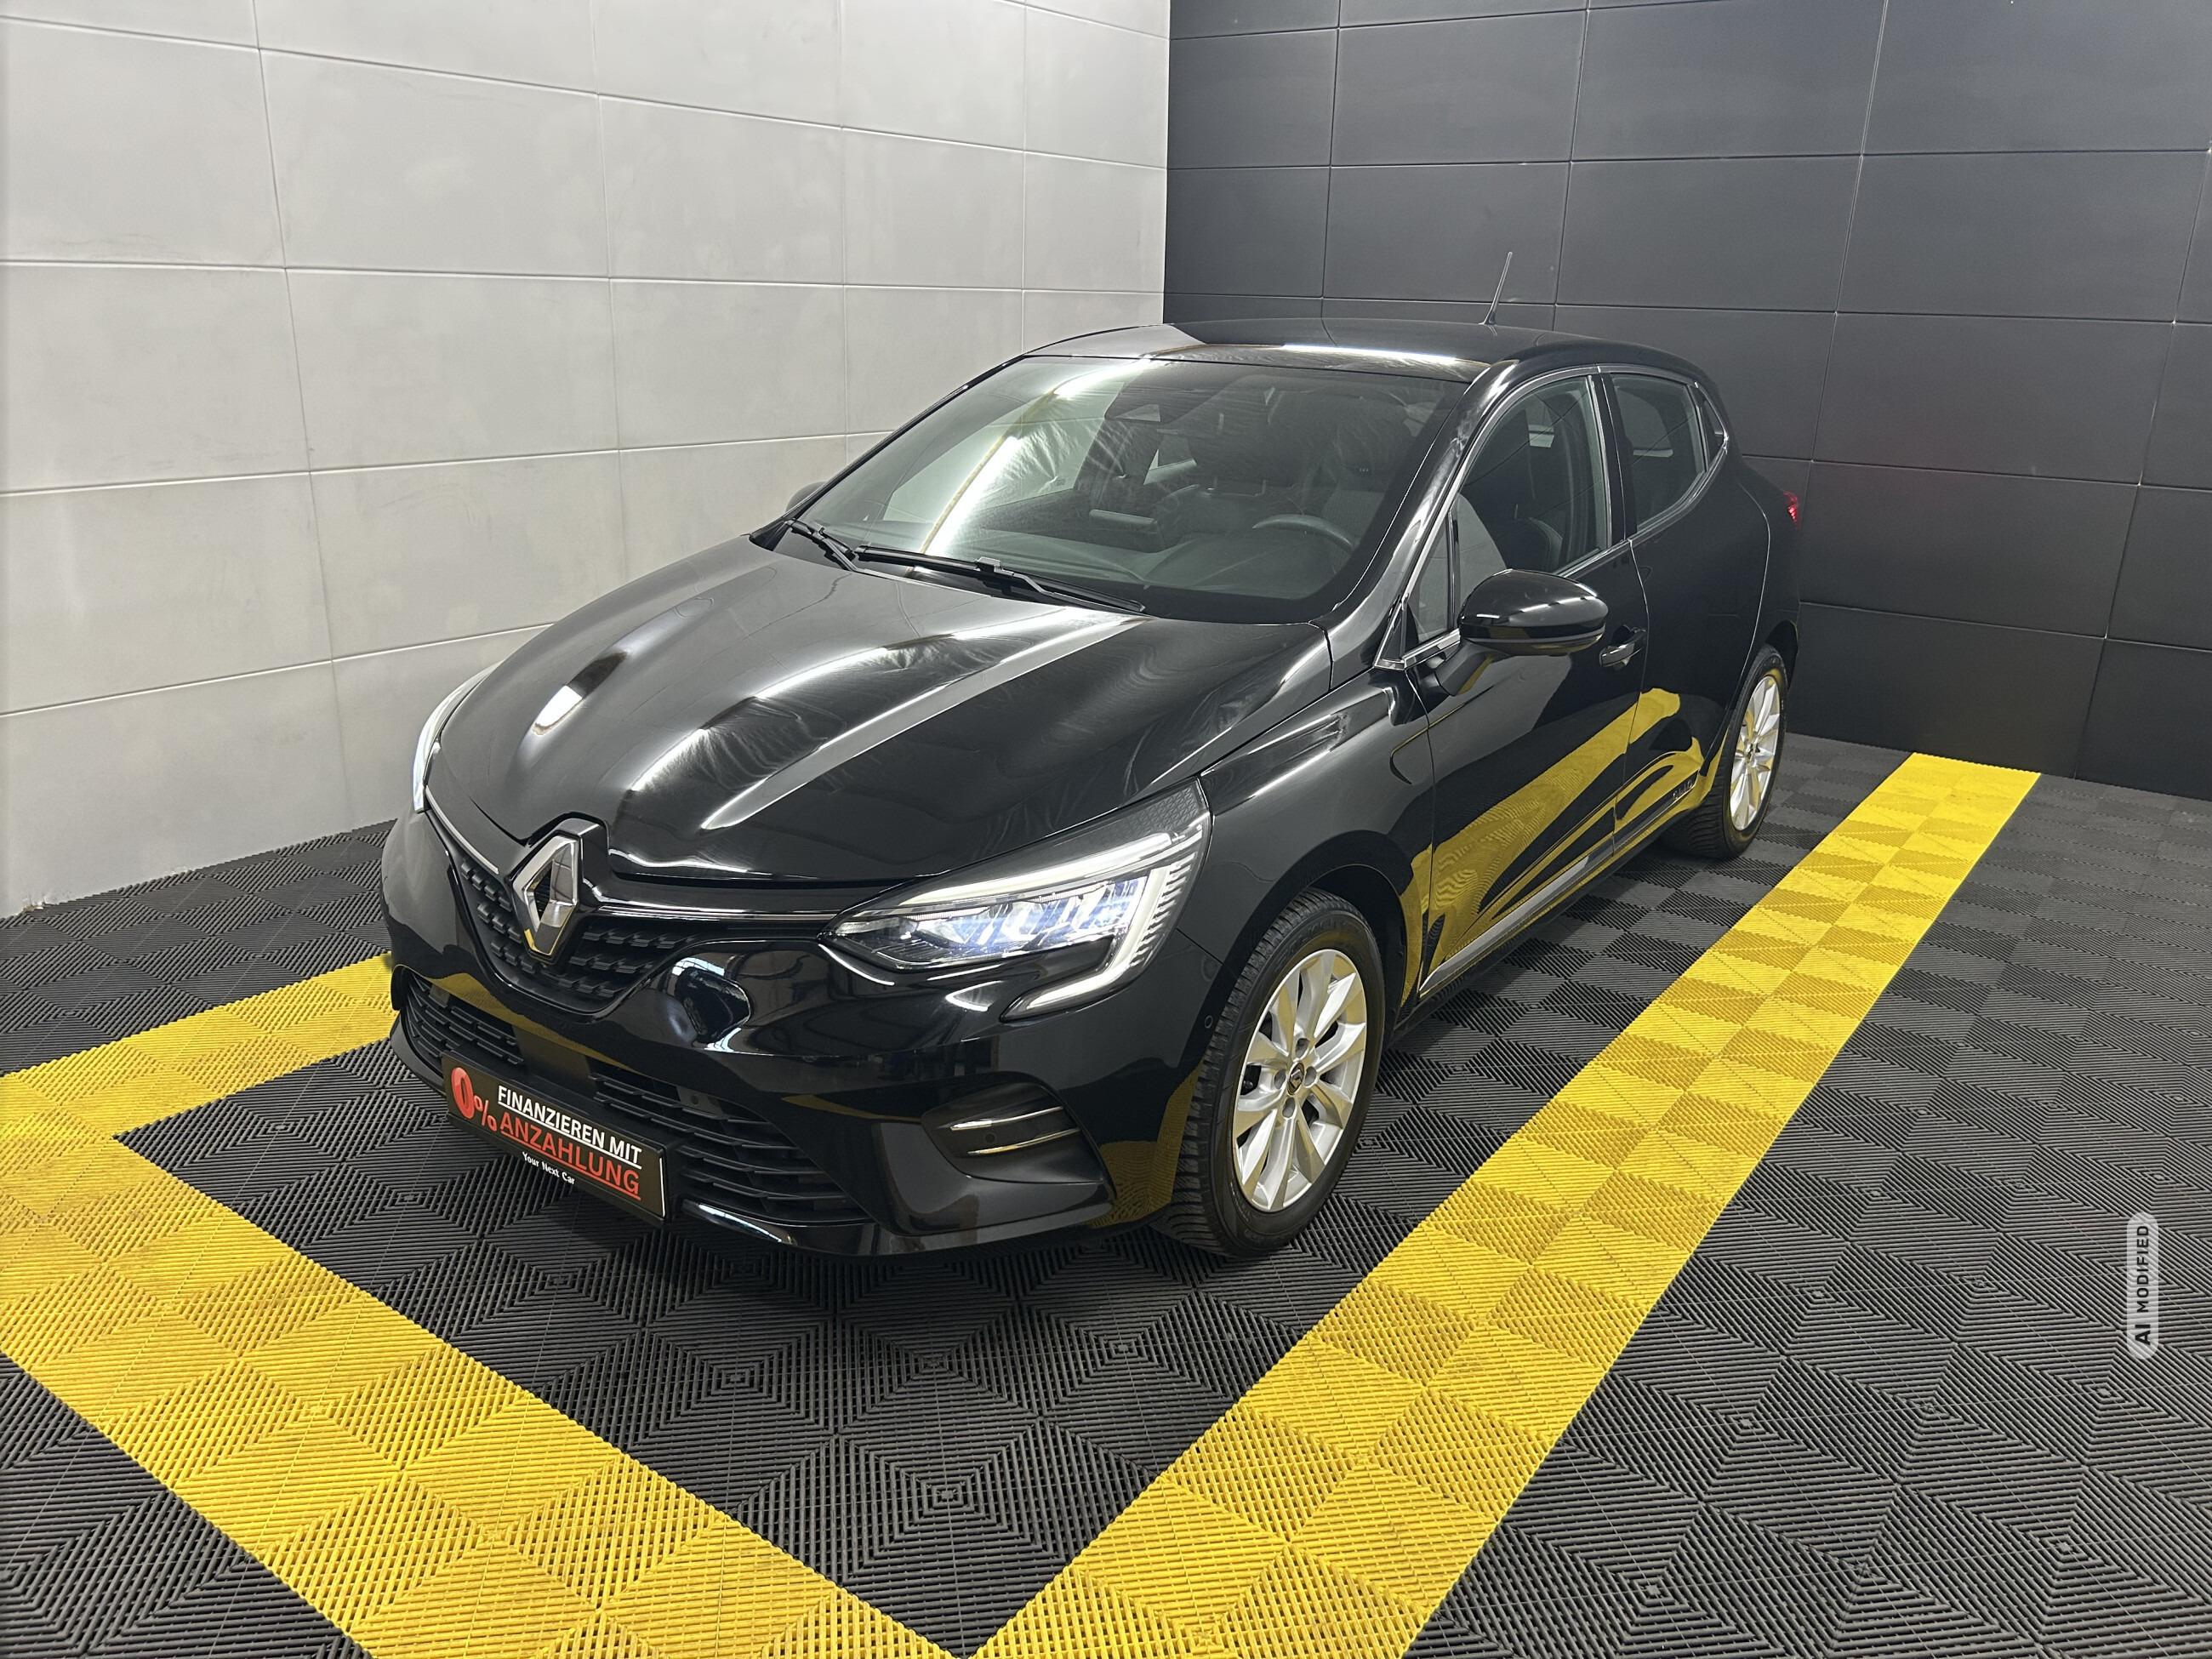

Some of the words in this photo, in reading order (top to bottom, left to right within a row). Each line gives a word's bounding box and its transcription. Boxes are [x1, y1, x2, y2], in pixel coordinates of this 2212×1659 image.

[451, 1067, 497, 1132] 0%
[500, 1112, 639, 1194] ANZAHLUNG
[498, 1085, 604, 1149] FINANZIEREN
[609, 1136, 642, 1164] MIT
[522, 1151, 539, 1167] Your
[541, 1161, 560, 1177] Next
[562, 1172, 575, 1184] Car
